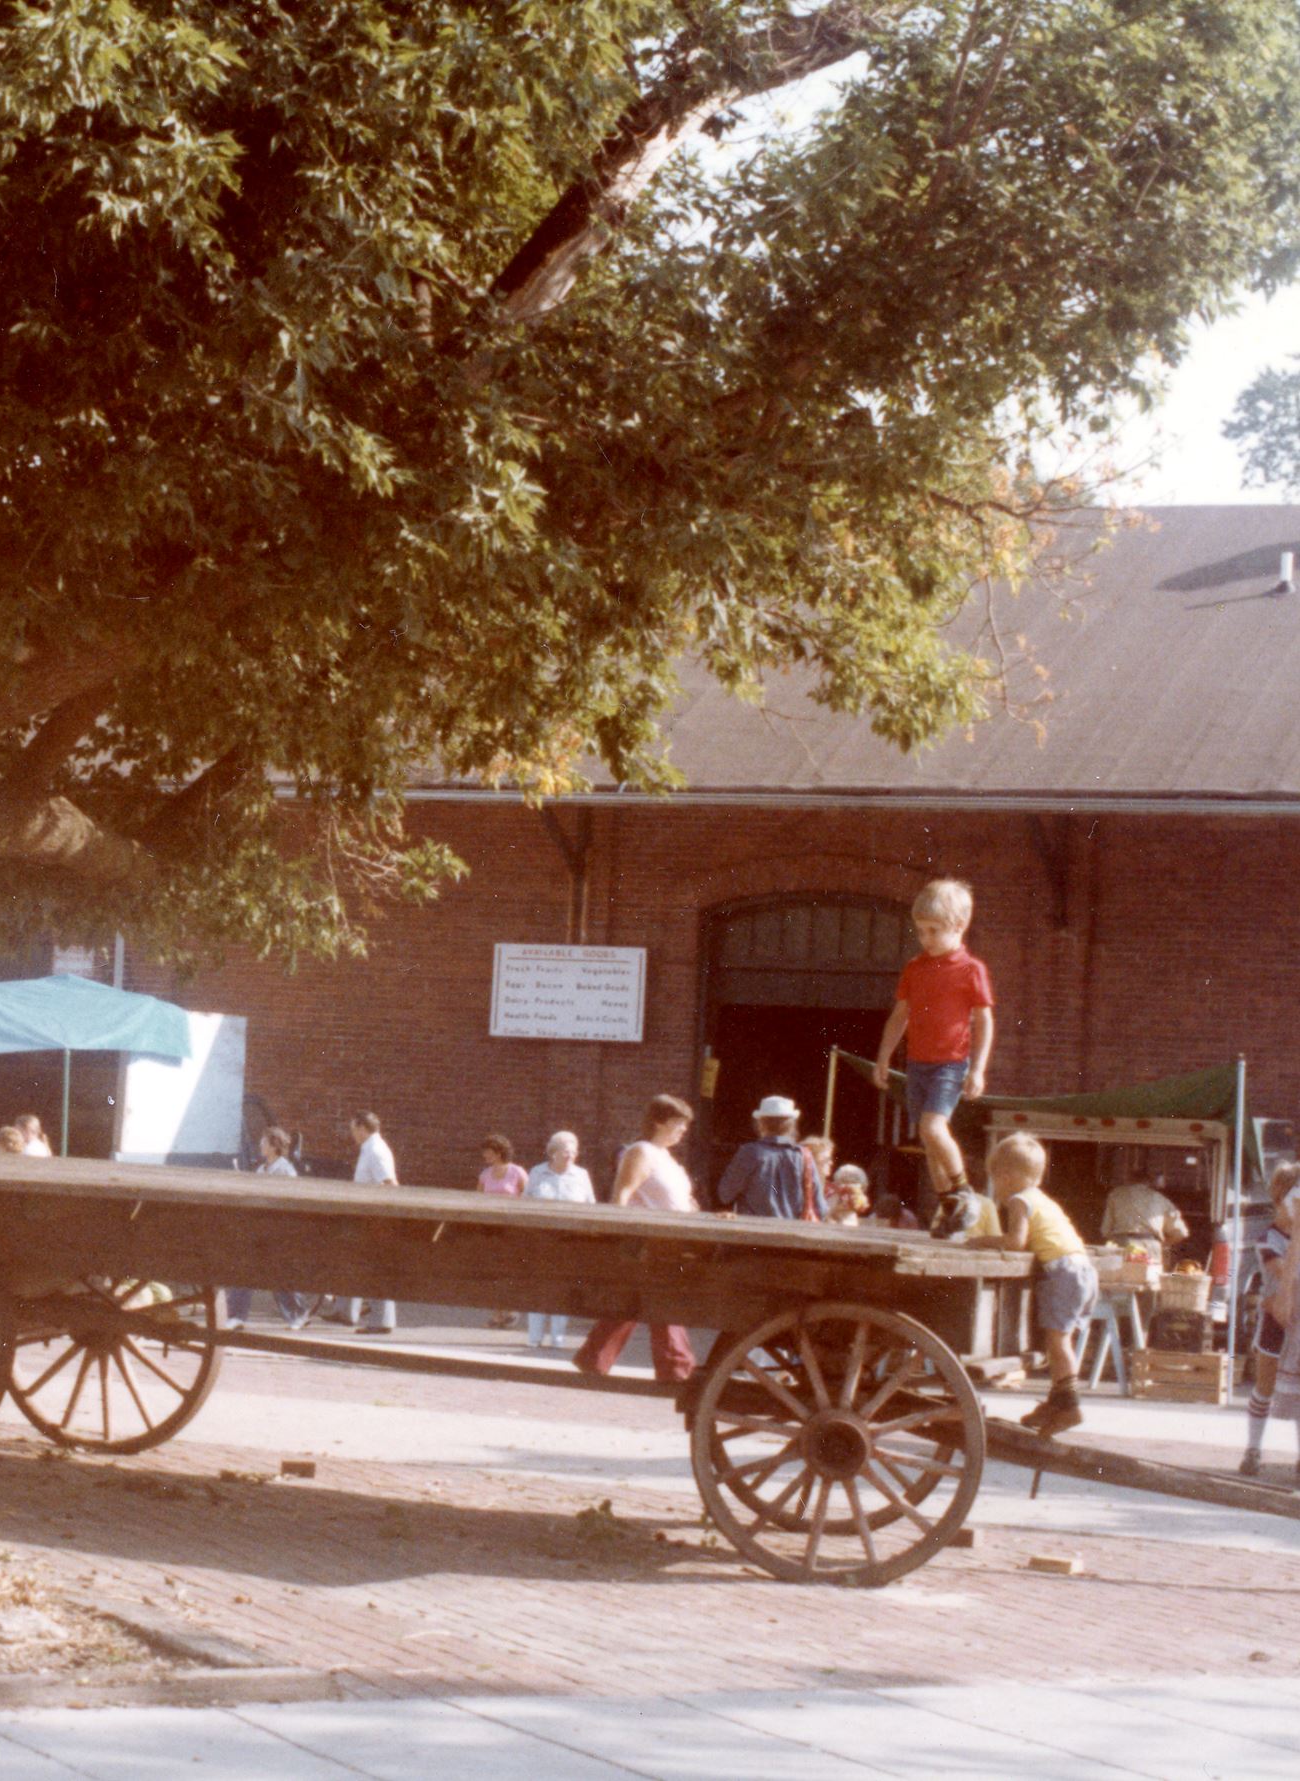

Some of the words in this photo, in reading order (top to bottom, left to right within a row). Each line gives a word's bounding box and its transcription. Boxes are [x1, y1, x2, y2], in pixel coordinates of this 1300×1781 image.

[522, 948, 572, 957] AVAILABLE
[583, 949, 617, 958] GOODS
[581, 966, 631, 976] Vegetables
